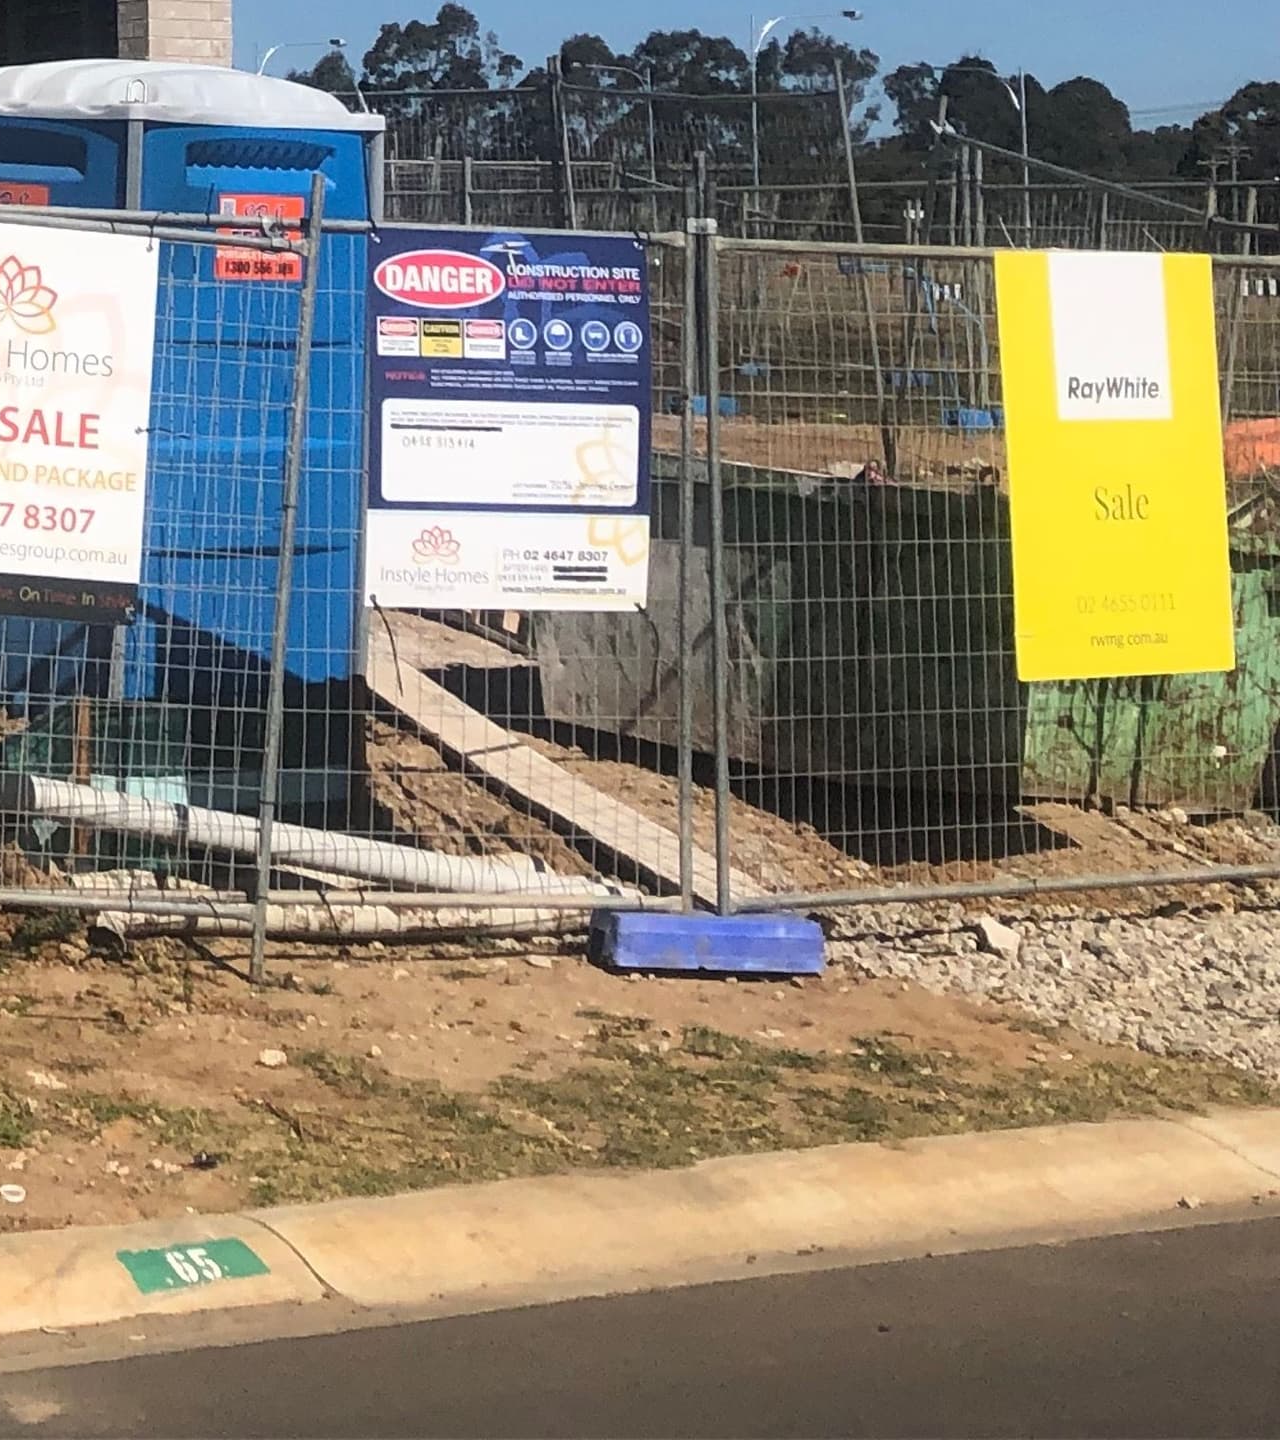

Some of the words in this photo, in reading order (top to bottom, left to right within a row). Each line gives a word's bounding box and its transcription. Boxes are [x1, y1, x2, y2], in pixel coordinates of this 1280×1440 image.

[384, 263, 495, 295] DANGER
[506, 264, 611, 280] CONSTRUCTION
[613, 266, 641, 281] SITE
[541, 278, 578, 291] NOT
[581, 279, 642, 293] ENTER
[6, 338, 114, 378] Homes
[4, 372, 21, 387] Pty
[24, 375, 45, 388] Ltd
[1067, 376, 1160, 404] RayWhite
[34, 463, 138, 492] PACKAGE
[1093, 483, 1150, 521] Sale
[22, 503, 96, 534] 8307
[523, 550, 540, 561] 02
[543, 550, 574, 561] 4647
[380, 565, 432, 585] Instyle
[435, 568, 490, 585] Homes
[18, 585, 41, 602] On
[81, 591, 96, 606] In
[164, 1247, 223, 1283] 65
